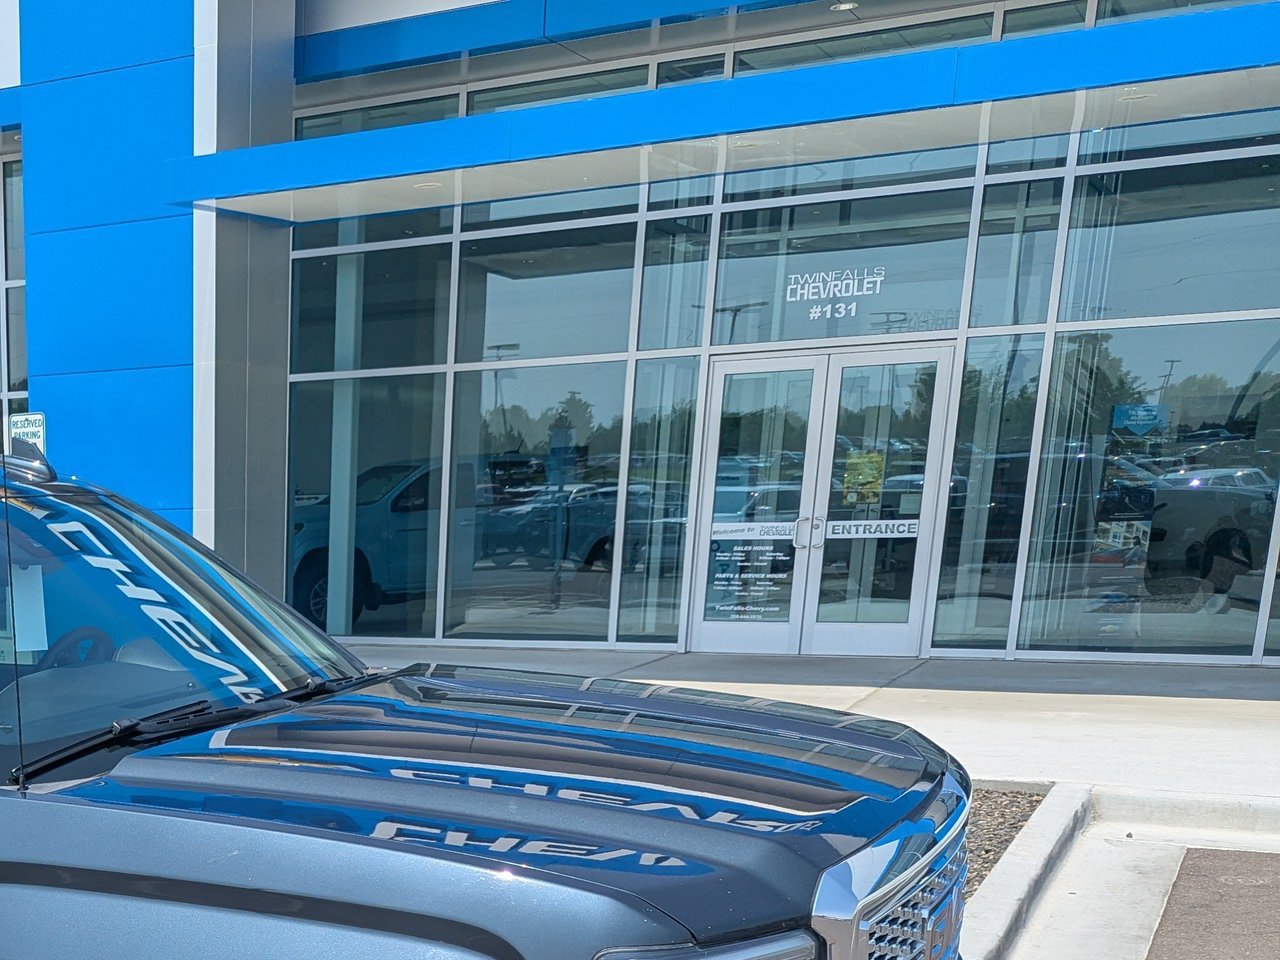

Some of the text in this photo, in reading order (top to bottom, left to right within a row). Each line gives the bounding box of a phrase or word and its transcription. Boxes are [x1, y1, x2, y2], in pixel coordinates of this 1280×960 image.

[787, 267, 885, 285] TWINFALLS
[786, 277, 884, 301] CHEVROLET
[809, 302, 857, 320] #131
[12, 418, 43, 429] RESERVED
[14, 430, 41, 439] PARKING
[712, 527, 745, 535] Welcome
[831, 523, 917, 534] ENTRANCE
